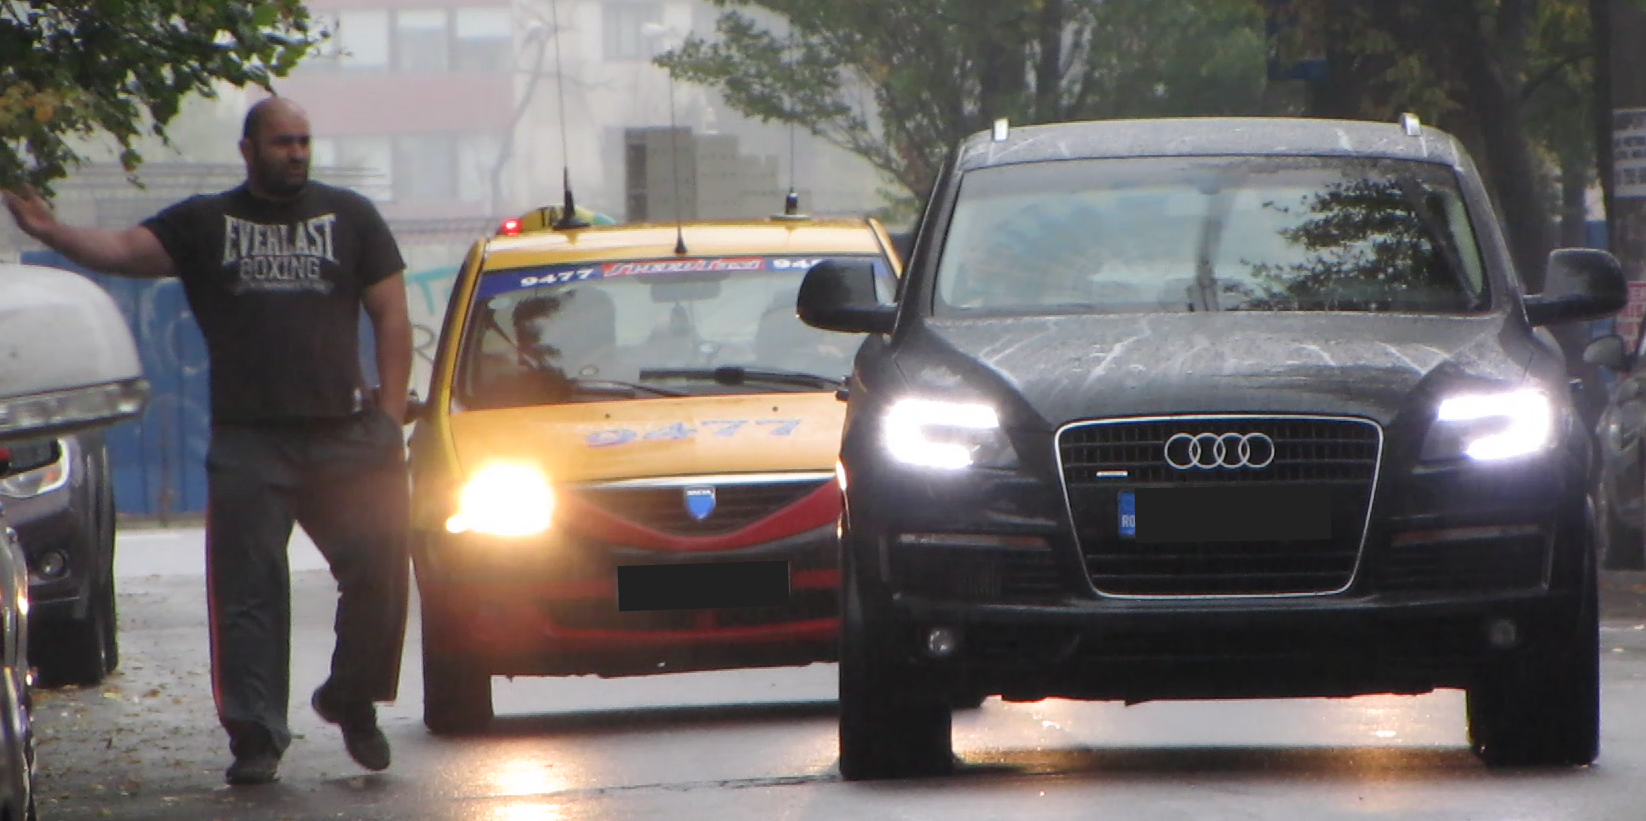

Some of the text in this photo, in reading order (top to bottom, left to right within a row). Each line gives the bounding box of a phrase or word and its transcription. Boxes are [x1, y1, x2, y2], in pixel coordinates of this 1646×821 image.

[222, 213, 339, 265] EVERLAST
[240, 256, 321, 280] BOXING
[520, 269, 594, 287] 9477
[586, 420, 801, 447] 9477
